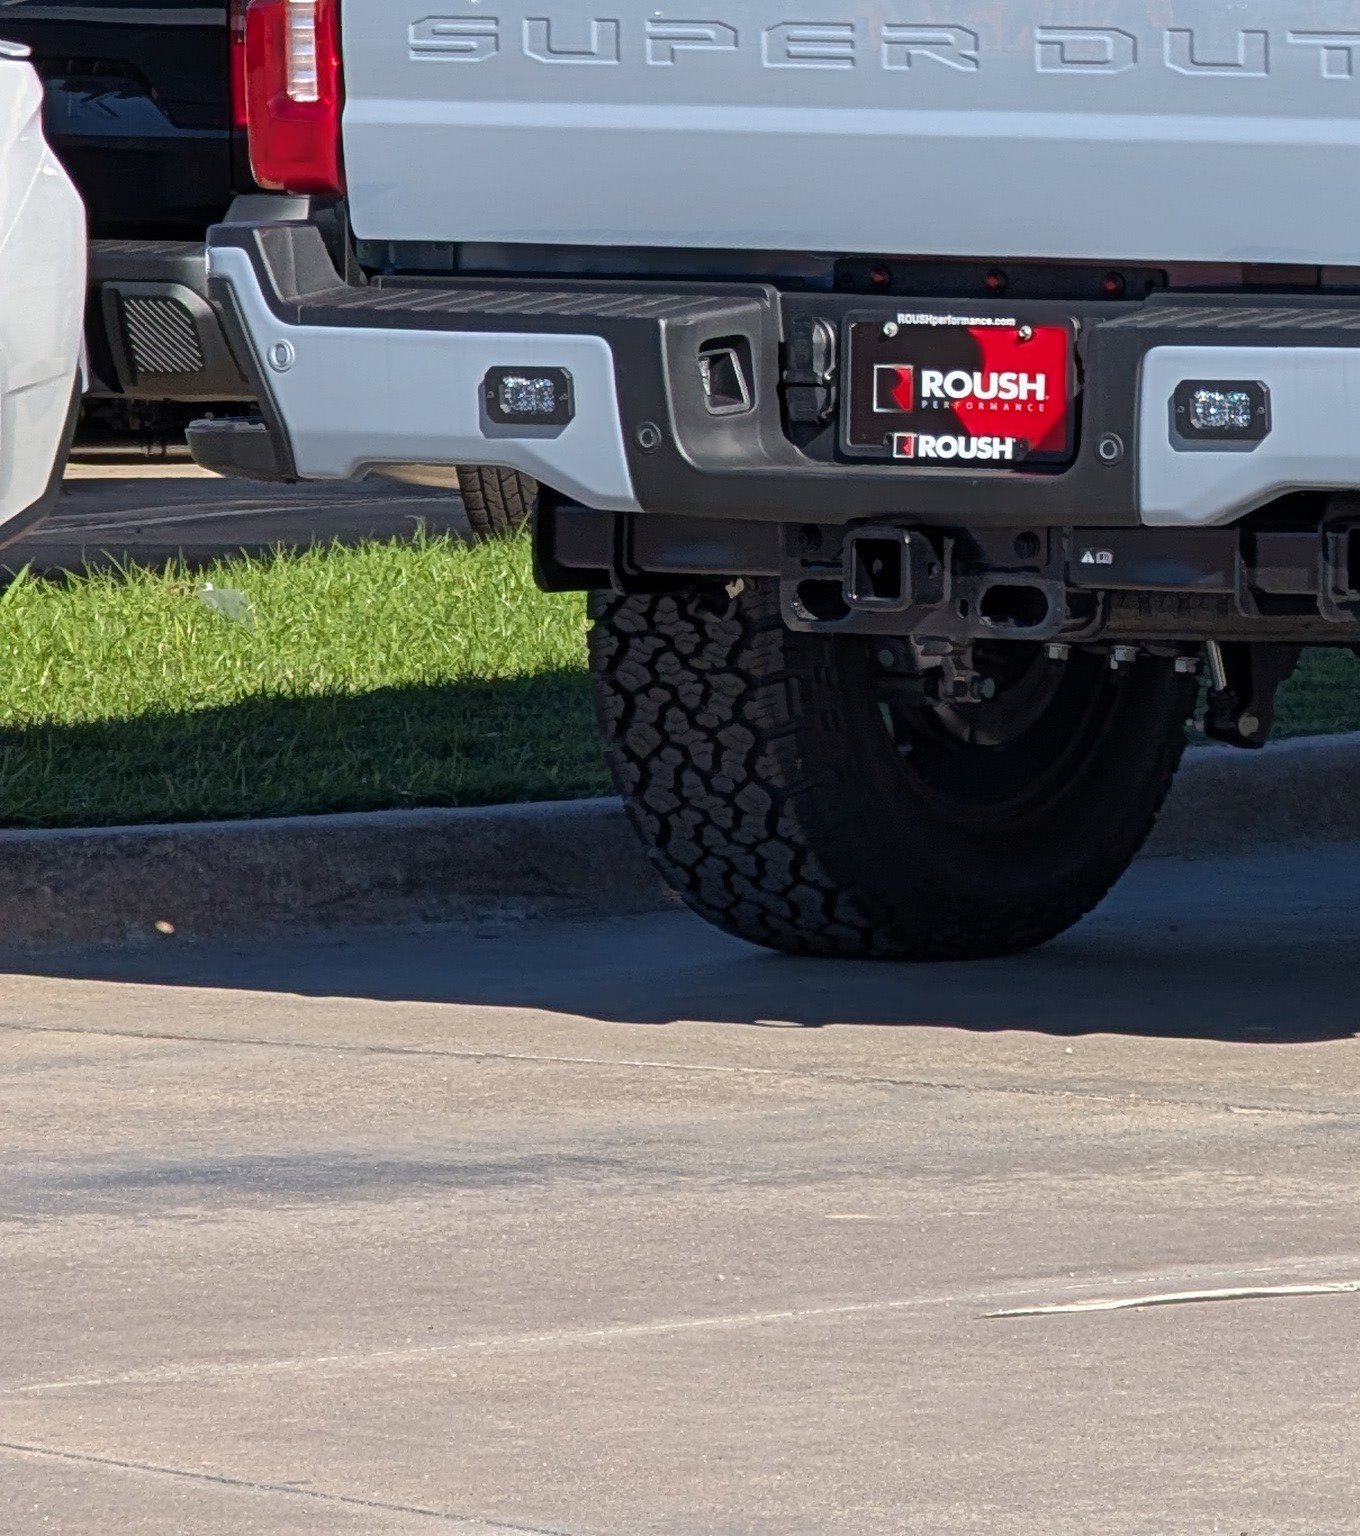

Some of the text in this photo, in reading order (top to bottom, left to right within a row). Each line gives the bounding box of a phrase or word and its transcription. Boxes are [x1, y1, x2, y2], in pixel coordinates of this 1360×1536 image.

[408, 14, 980, 73] SUPER
[897, 312, 1016, 327] ROUSHperformance.com
[920, 369, 1047, 401] ROUSH
[920, 399, 1045, 413] PERFORMANCE
[918, 434, 1014, 460] ROUSH
